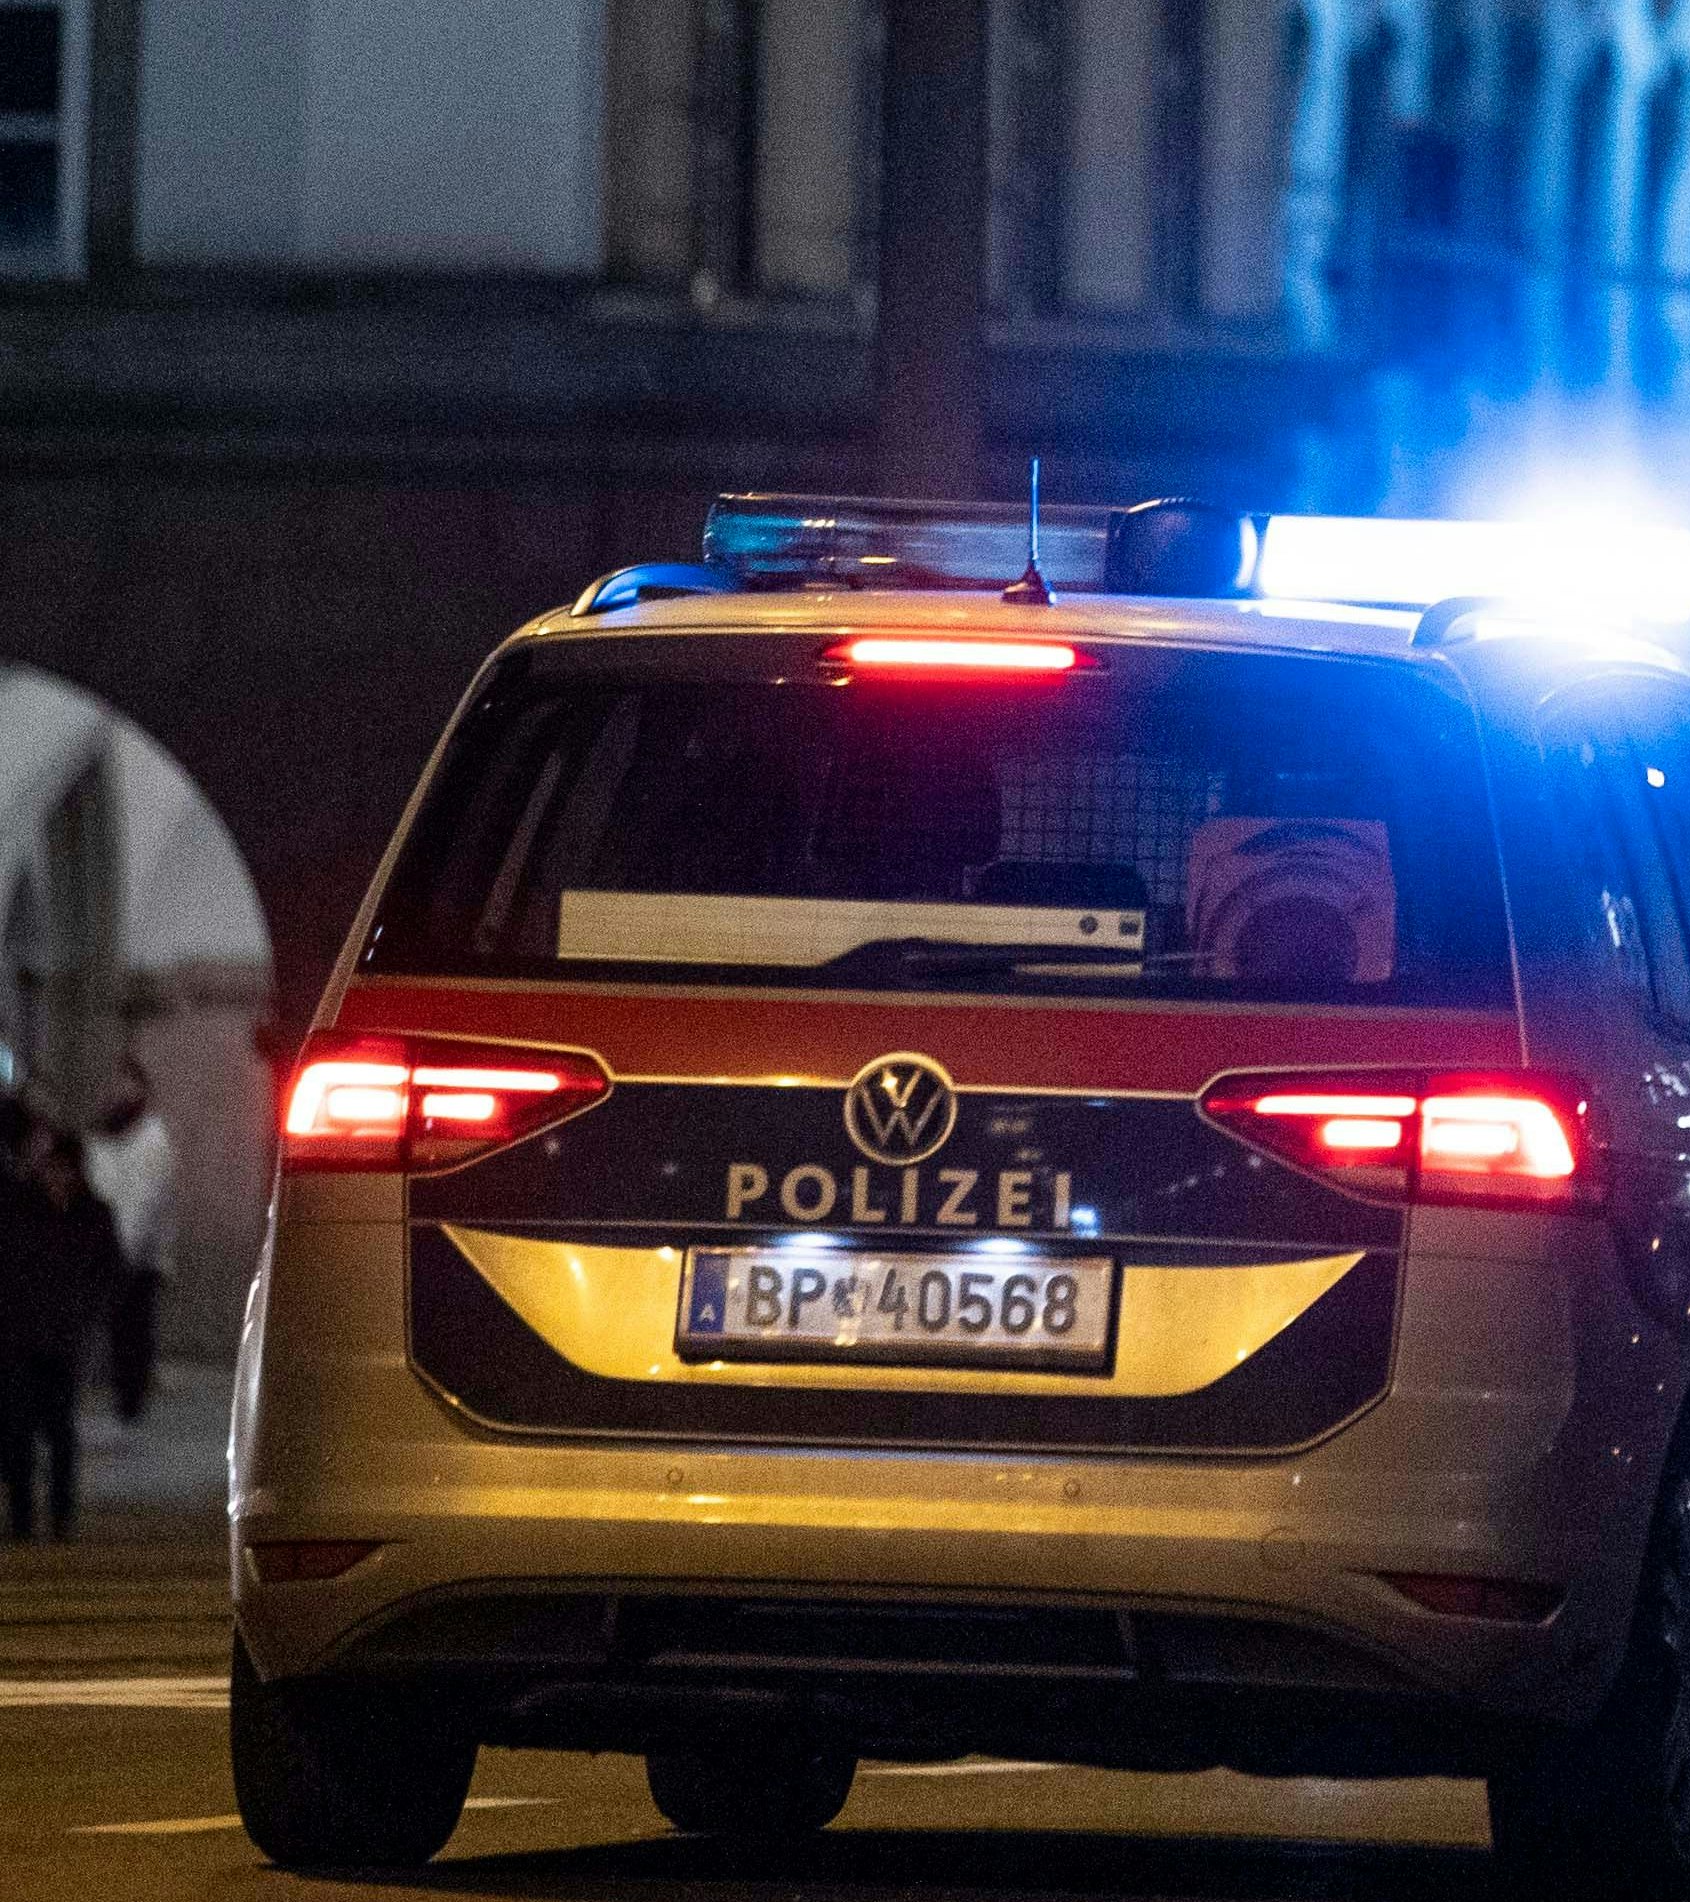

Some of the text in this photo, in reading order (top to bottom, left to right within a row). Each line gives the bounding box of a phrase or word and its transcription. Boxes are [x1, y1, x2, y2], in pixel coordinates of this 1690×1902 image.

[854, 1060, 948, 1154] VW
[726, 1162, 1072, 1228] POLIZEI
[744, 1265, 1080, 1337] BP 40568
